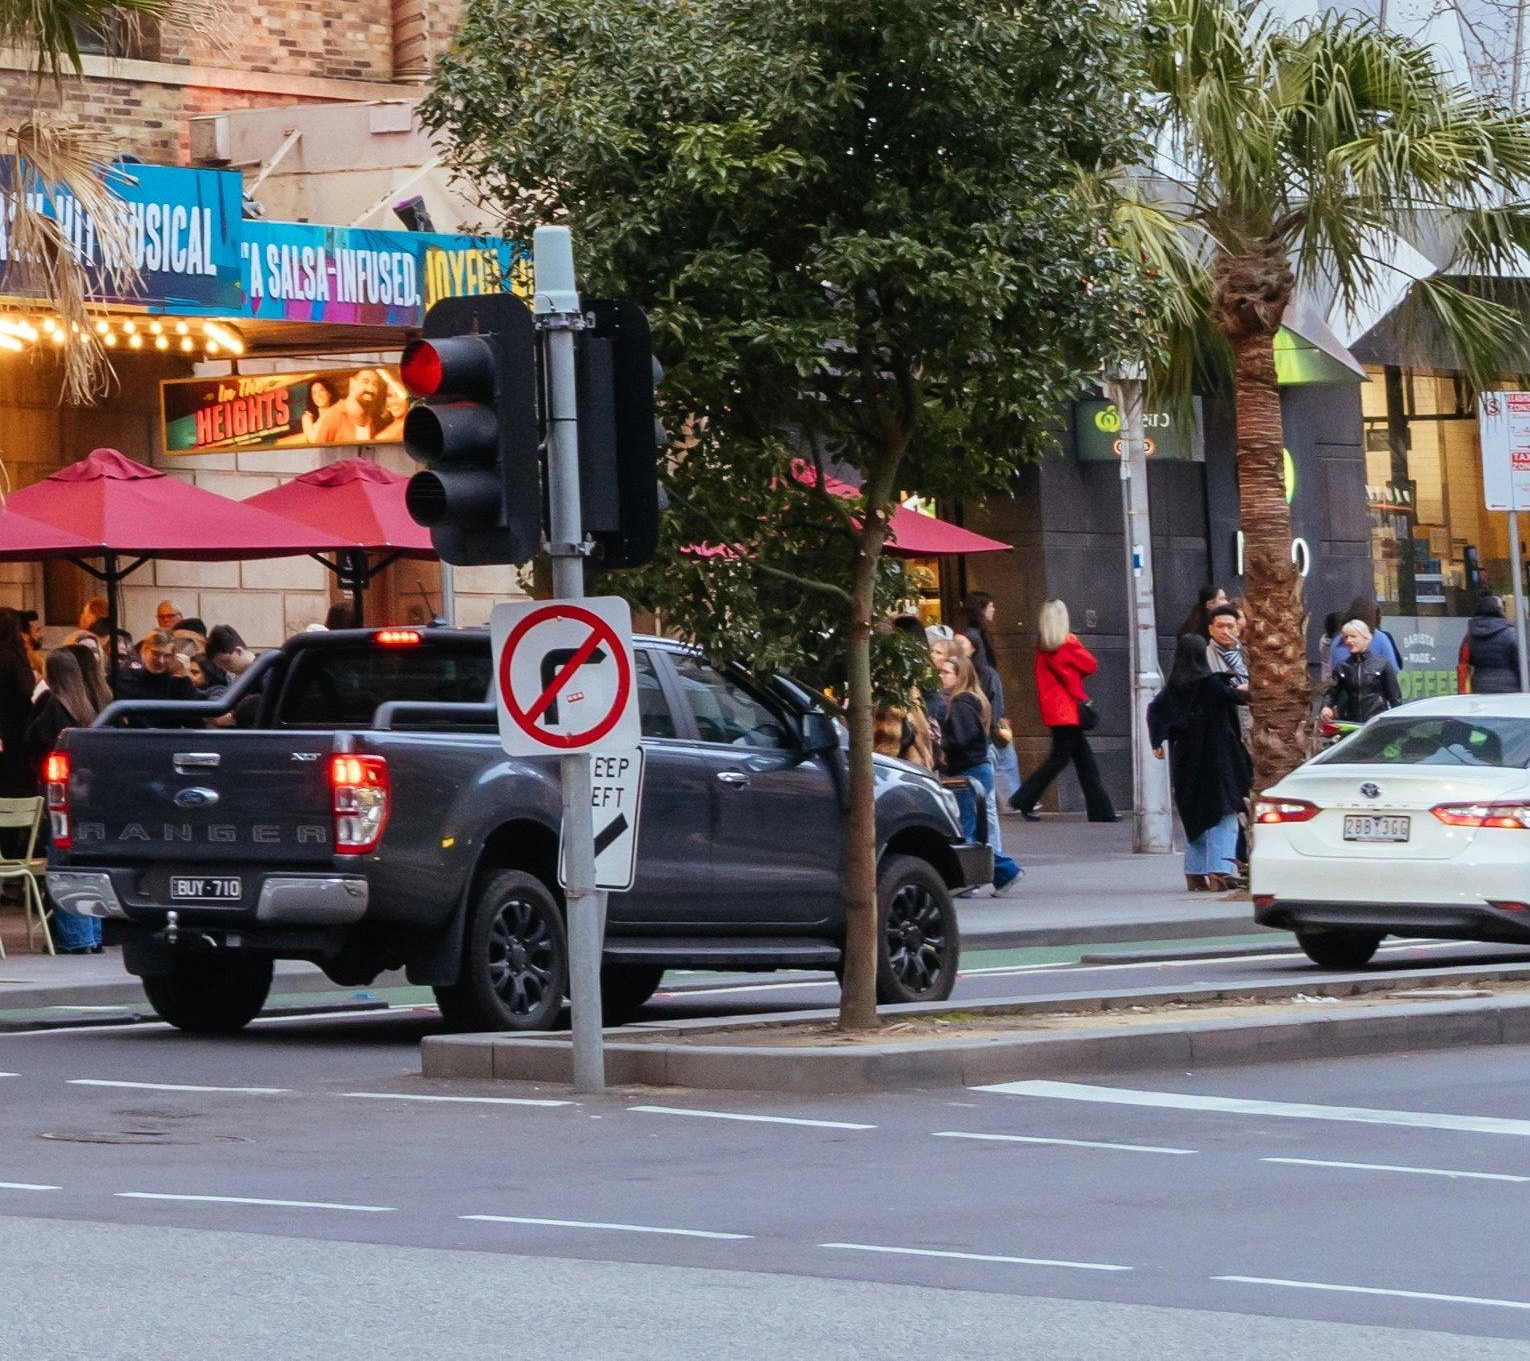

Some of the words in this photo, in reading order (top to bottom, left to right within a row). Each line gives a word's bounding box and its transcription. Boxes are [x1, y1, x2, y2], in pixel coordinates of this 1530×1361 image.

[105, 200, 217, 276] USICAL
[266, 243, 420, 308] SALSA-INFUSED,
[425, 248, 501, 312] JOY
[197, 386, 290, 445] HEIGHTS
[1403, 633, 1435, 648] BARISTA
[1397, 669, 1458, 700] OFFEE
[594, 757, 630, 778] EEP
[591, 786, 625, 808] EFT
[79, 822, 327, 843] RANGER
